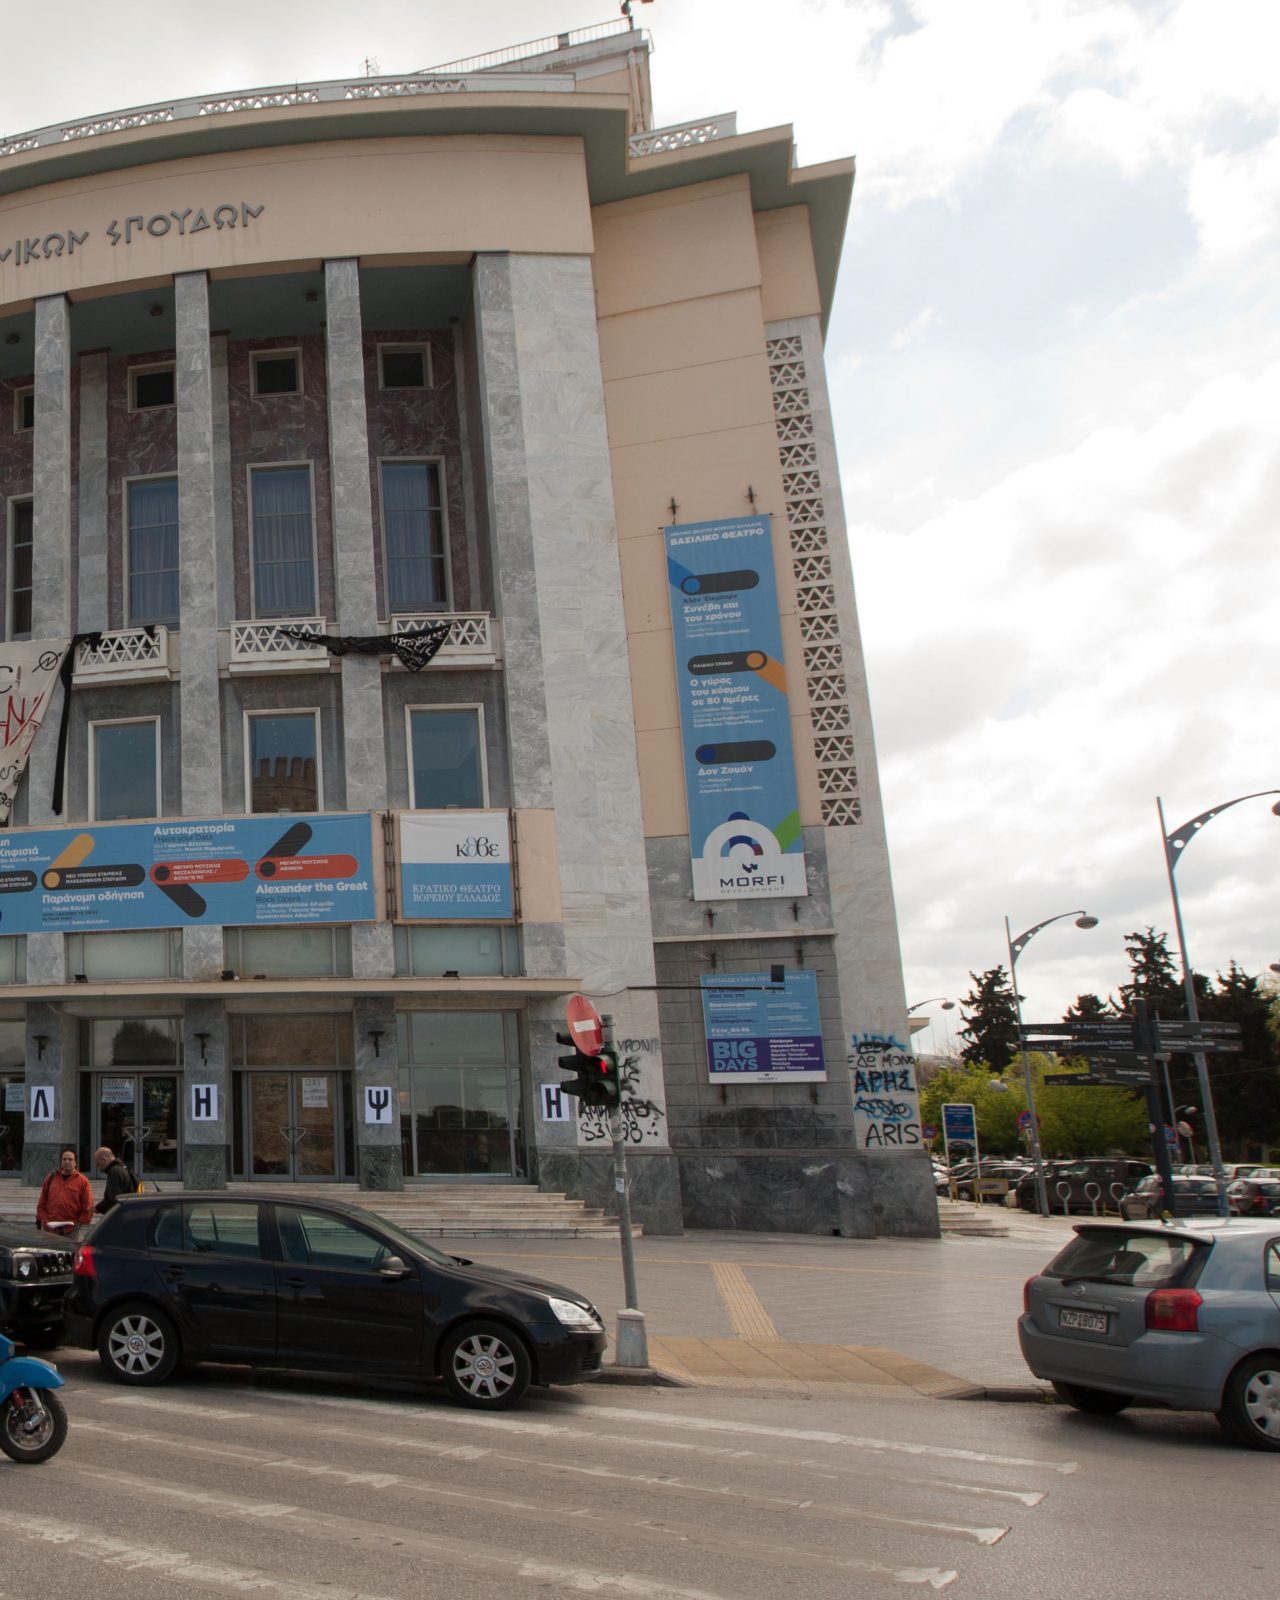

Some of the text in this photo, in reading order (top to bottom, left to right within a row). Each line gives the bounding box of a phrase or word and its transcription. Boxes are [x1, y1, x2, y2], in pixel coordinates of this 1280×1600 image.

[670, 527, 764, 546] ΒΑΣΙΛΙΚΟ ΘΕΑΤΡΟ
[684, 615, 702, 623] του
[701, 676, 732, 687] γύρος
[690, 685, 750, 697] του κόσμου
[707, 697, 721, 705] 80
[723, 694, 760, 704] ημέρες
[698, 766, 754, 777] Δον Ζουάν
[153, 823, 235, 836] Αυτοκρατορία
[256, 881, 369, 894] Alexander the Great
[720, 875, 785, 888] MORFI
[412, 884, 501, 893] ΚΡΑΤΙΚΟ ΘΕΑΤΡΟ
[42, 890, 145, 904] Παράνομη οδήγηση
[412, 893, 502, 902] ΒΟΡΕΙΟΥ ΕΛΛΑΔΟΣ
[712, 1041, 758, 1059] BIG
[714, 1059, 758, 1071] DAYS
[854, 1069, 916, 1093] ΑΡΗΣ
[865, 1123, 920, 1148] ARIS
